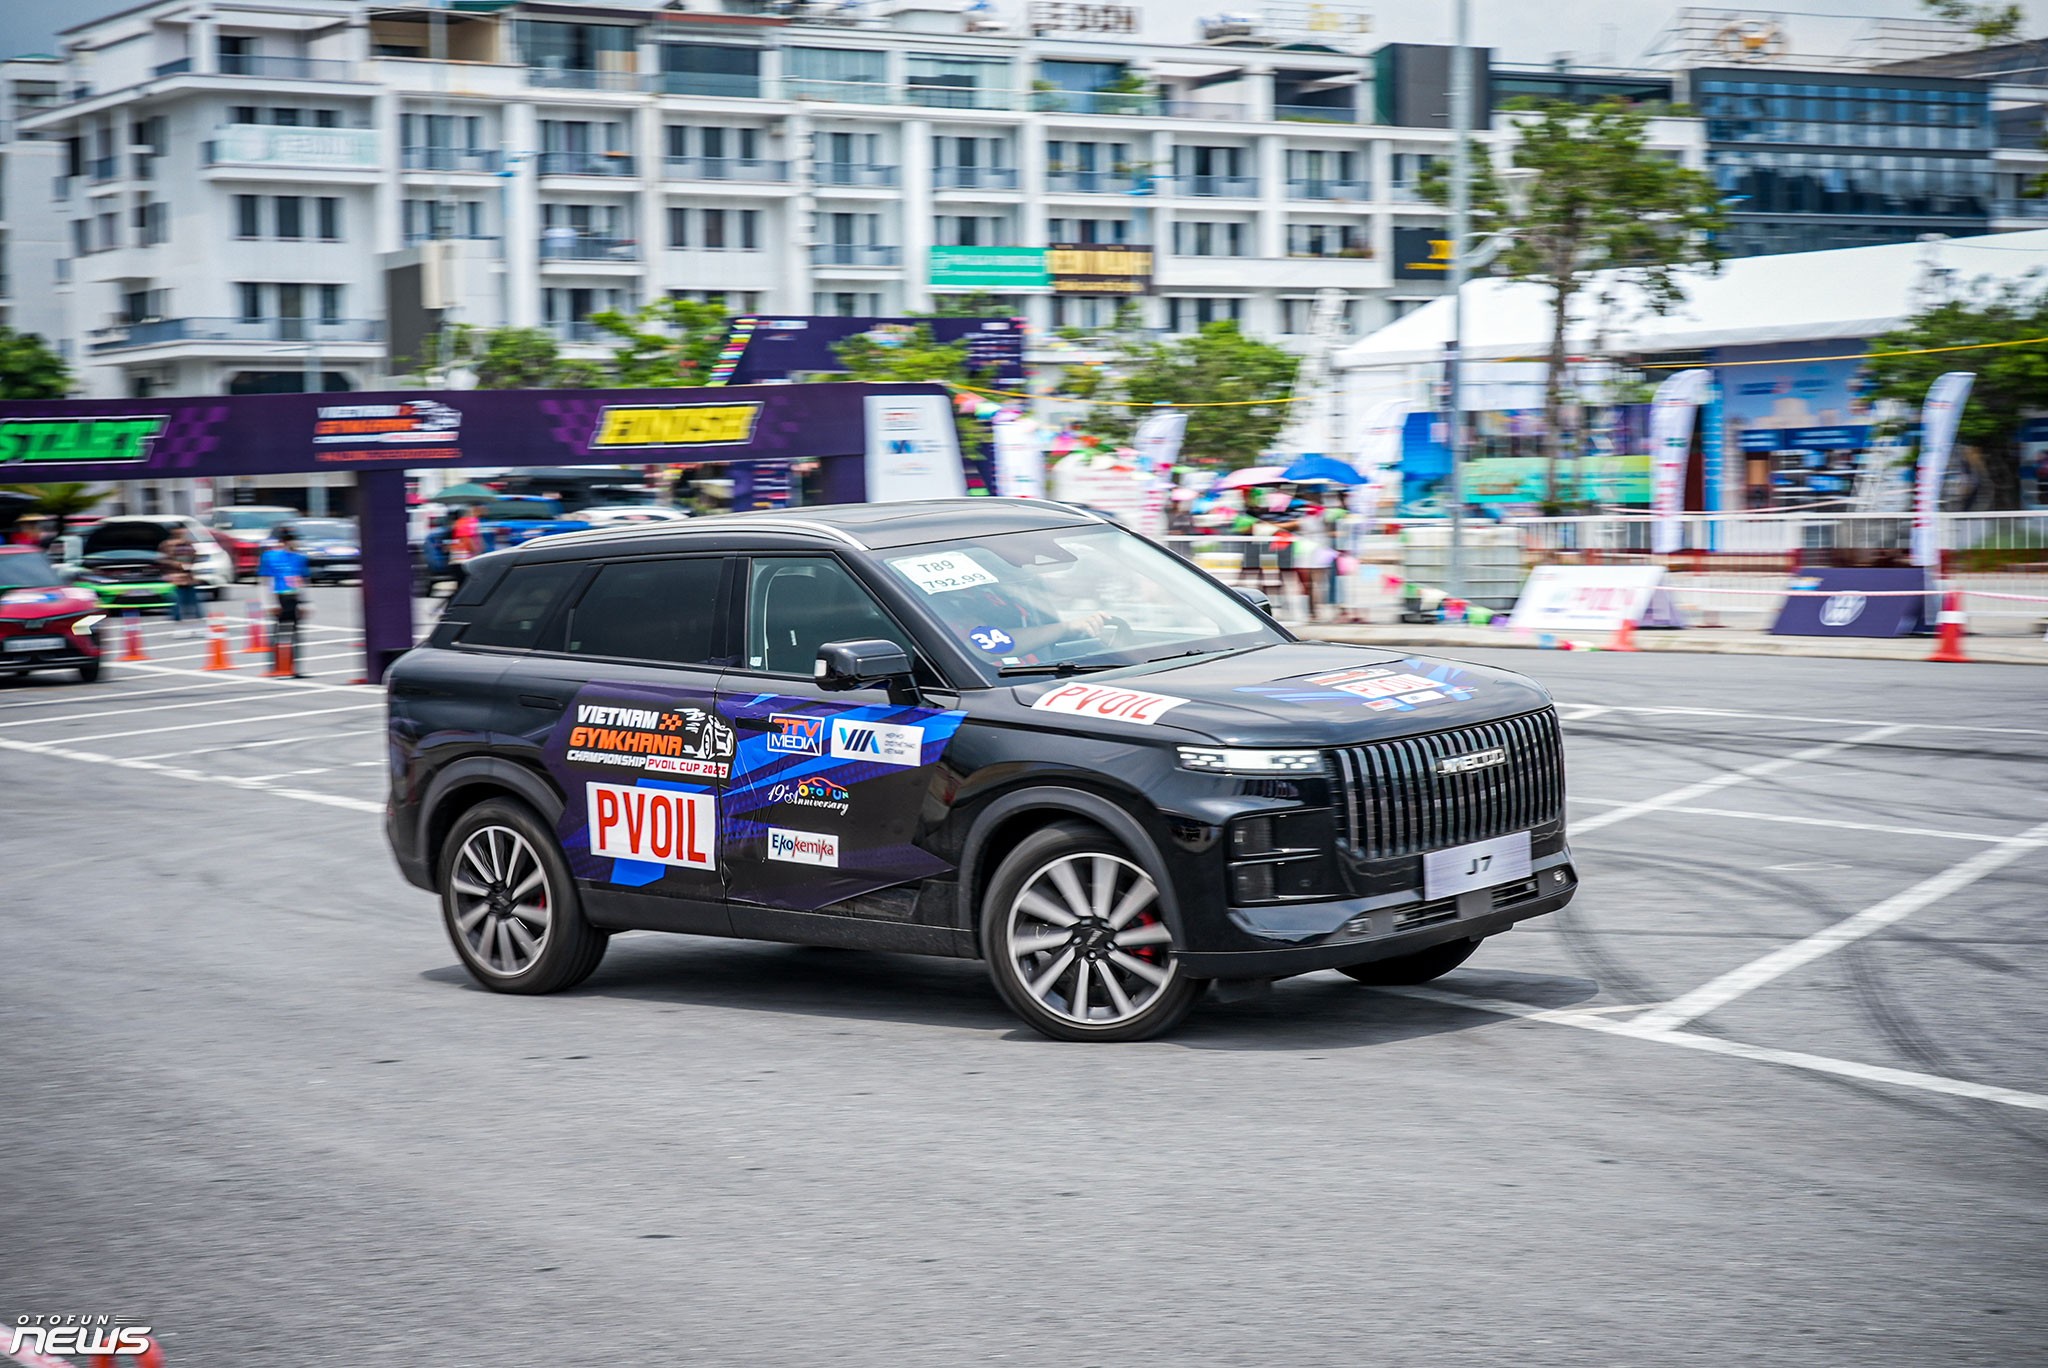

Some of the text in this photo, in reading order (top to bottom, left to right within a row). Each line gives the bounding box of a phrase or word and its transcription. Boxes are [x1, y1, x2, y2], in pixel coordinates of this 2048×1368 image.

[970, 629, 1011, 650] 34
[1045, 686, 1164, 719] PVOIL
[577, 704, 660, 730] VIETNAM
[569, 726, 683, 757] GYMKHANA
[771, 734, 819, 754] MEDIA
[566, 749, 727, 776] CHAMPIONSHIP PVOIL CUP 2025
[784, 791, 849, 816] Anniversary
[799, 785, 849, 800] OTOFUN
[596, 789, 706, 863] PVOIL
[772, 834, 834, 861] Ekokemika
[1465, 855, 1493, 875] J7
